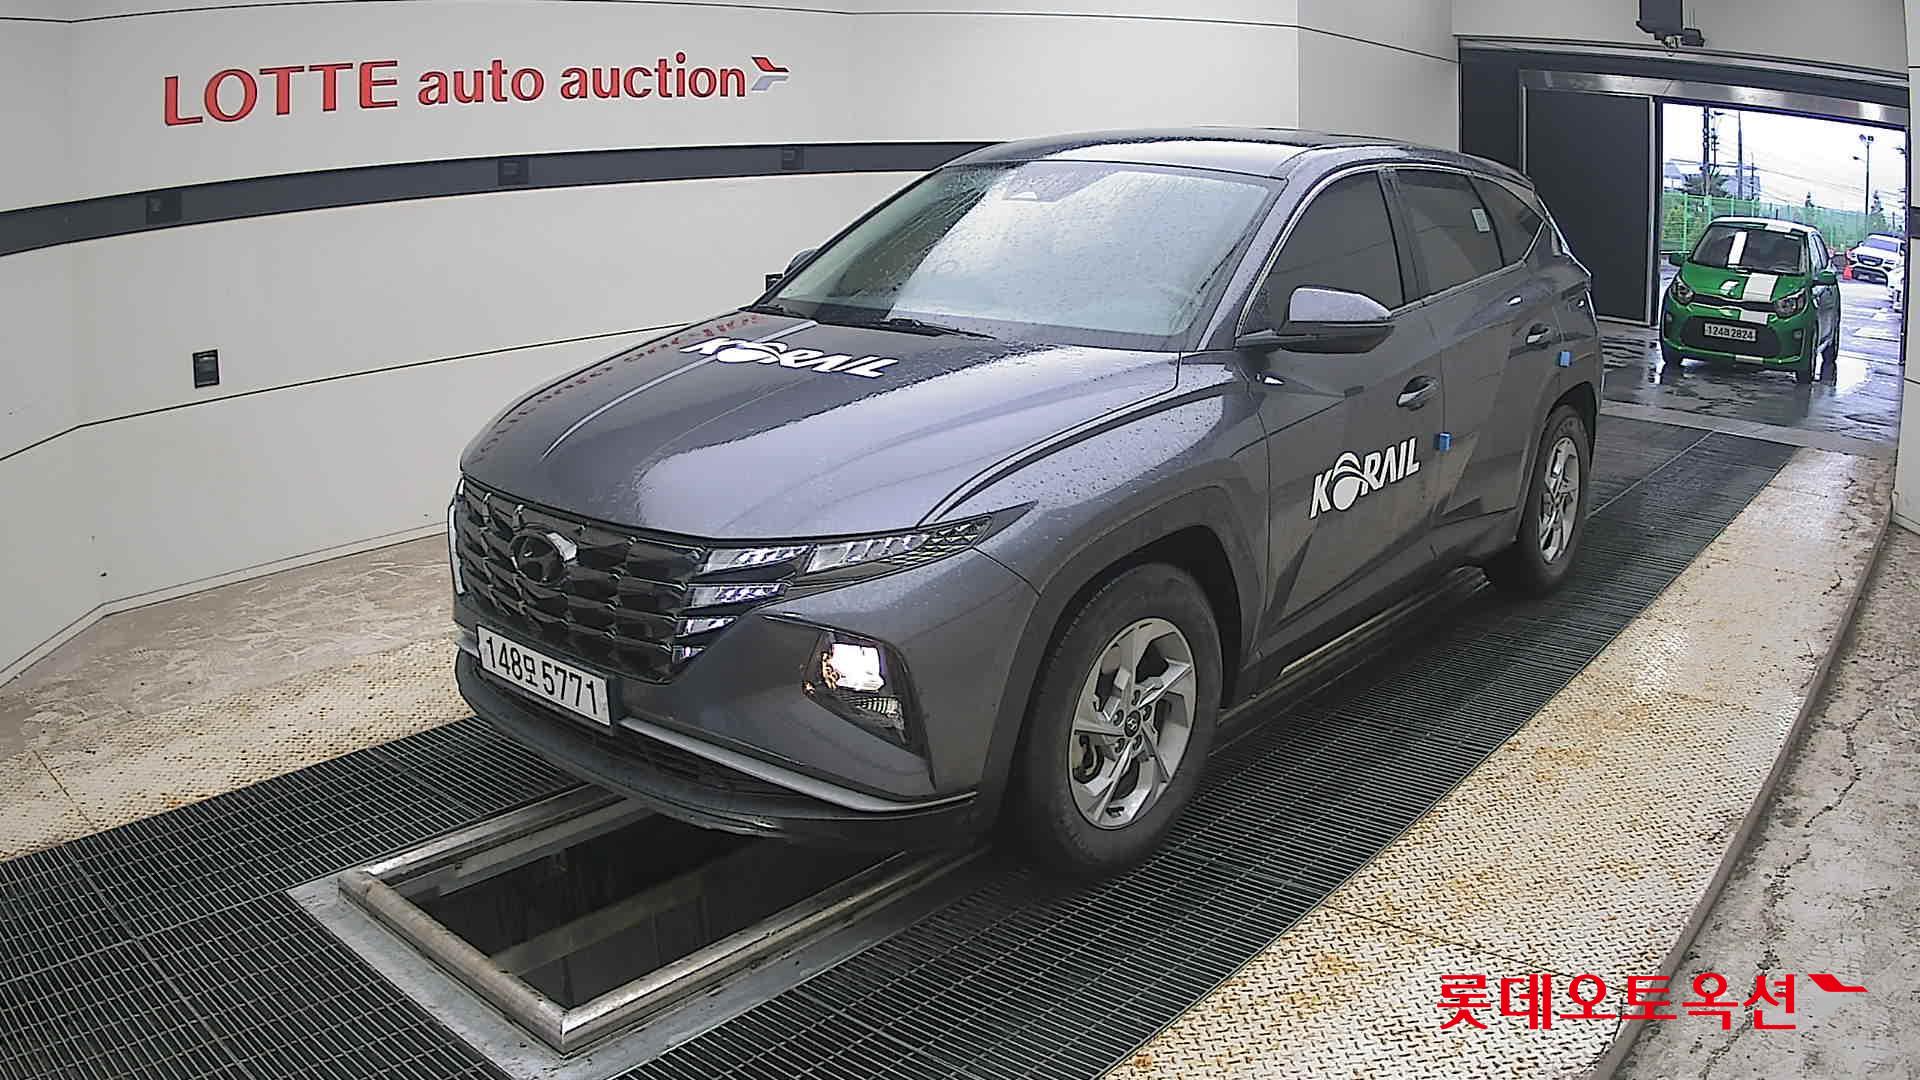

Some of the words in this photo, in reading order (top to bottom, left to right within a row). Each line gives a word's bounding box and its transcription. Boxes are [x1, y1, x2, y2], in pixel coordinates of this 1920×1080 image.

[164, 60, 398, 126] LOTTE
[418, 60, 545, 104] auto
[561, 52, 747, 98] auction
[1310, 436, 1420, 519] KORAIL
[541, 661, 597, 715] 5771
